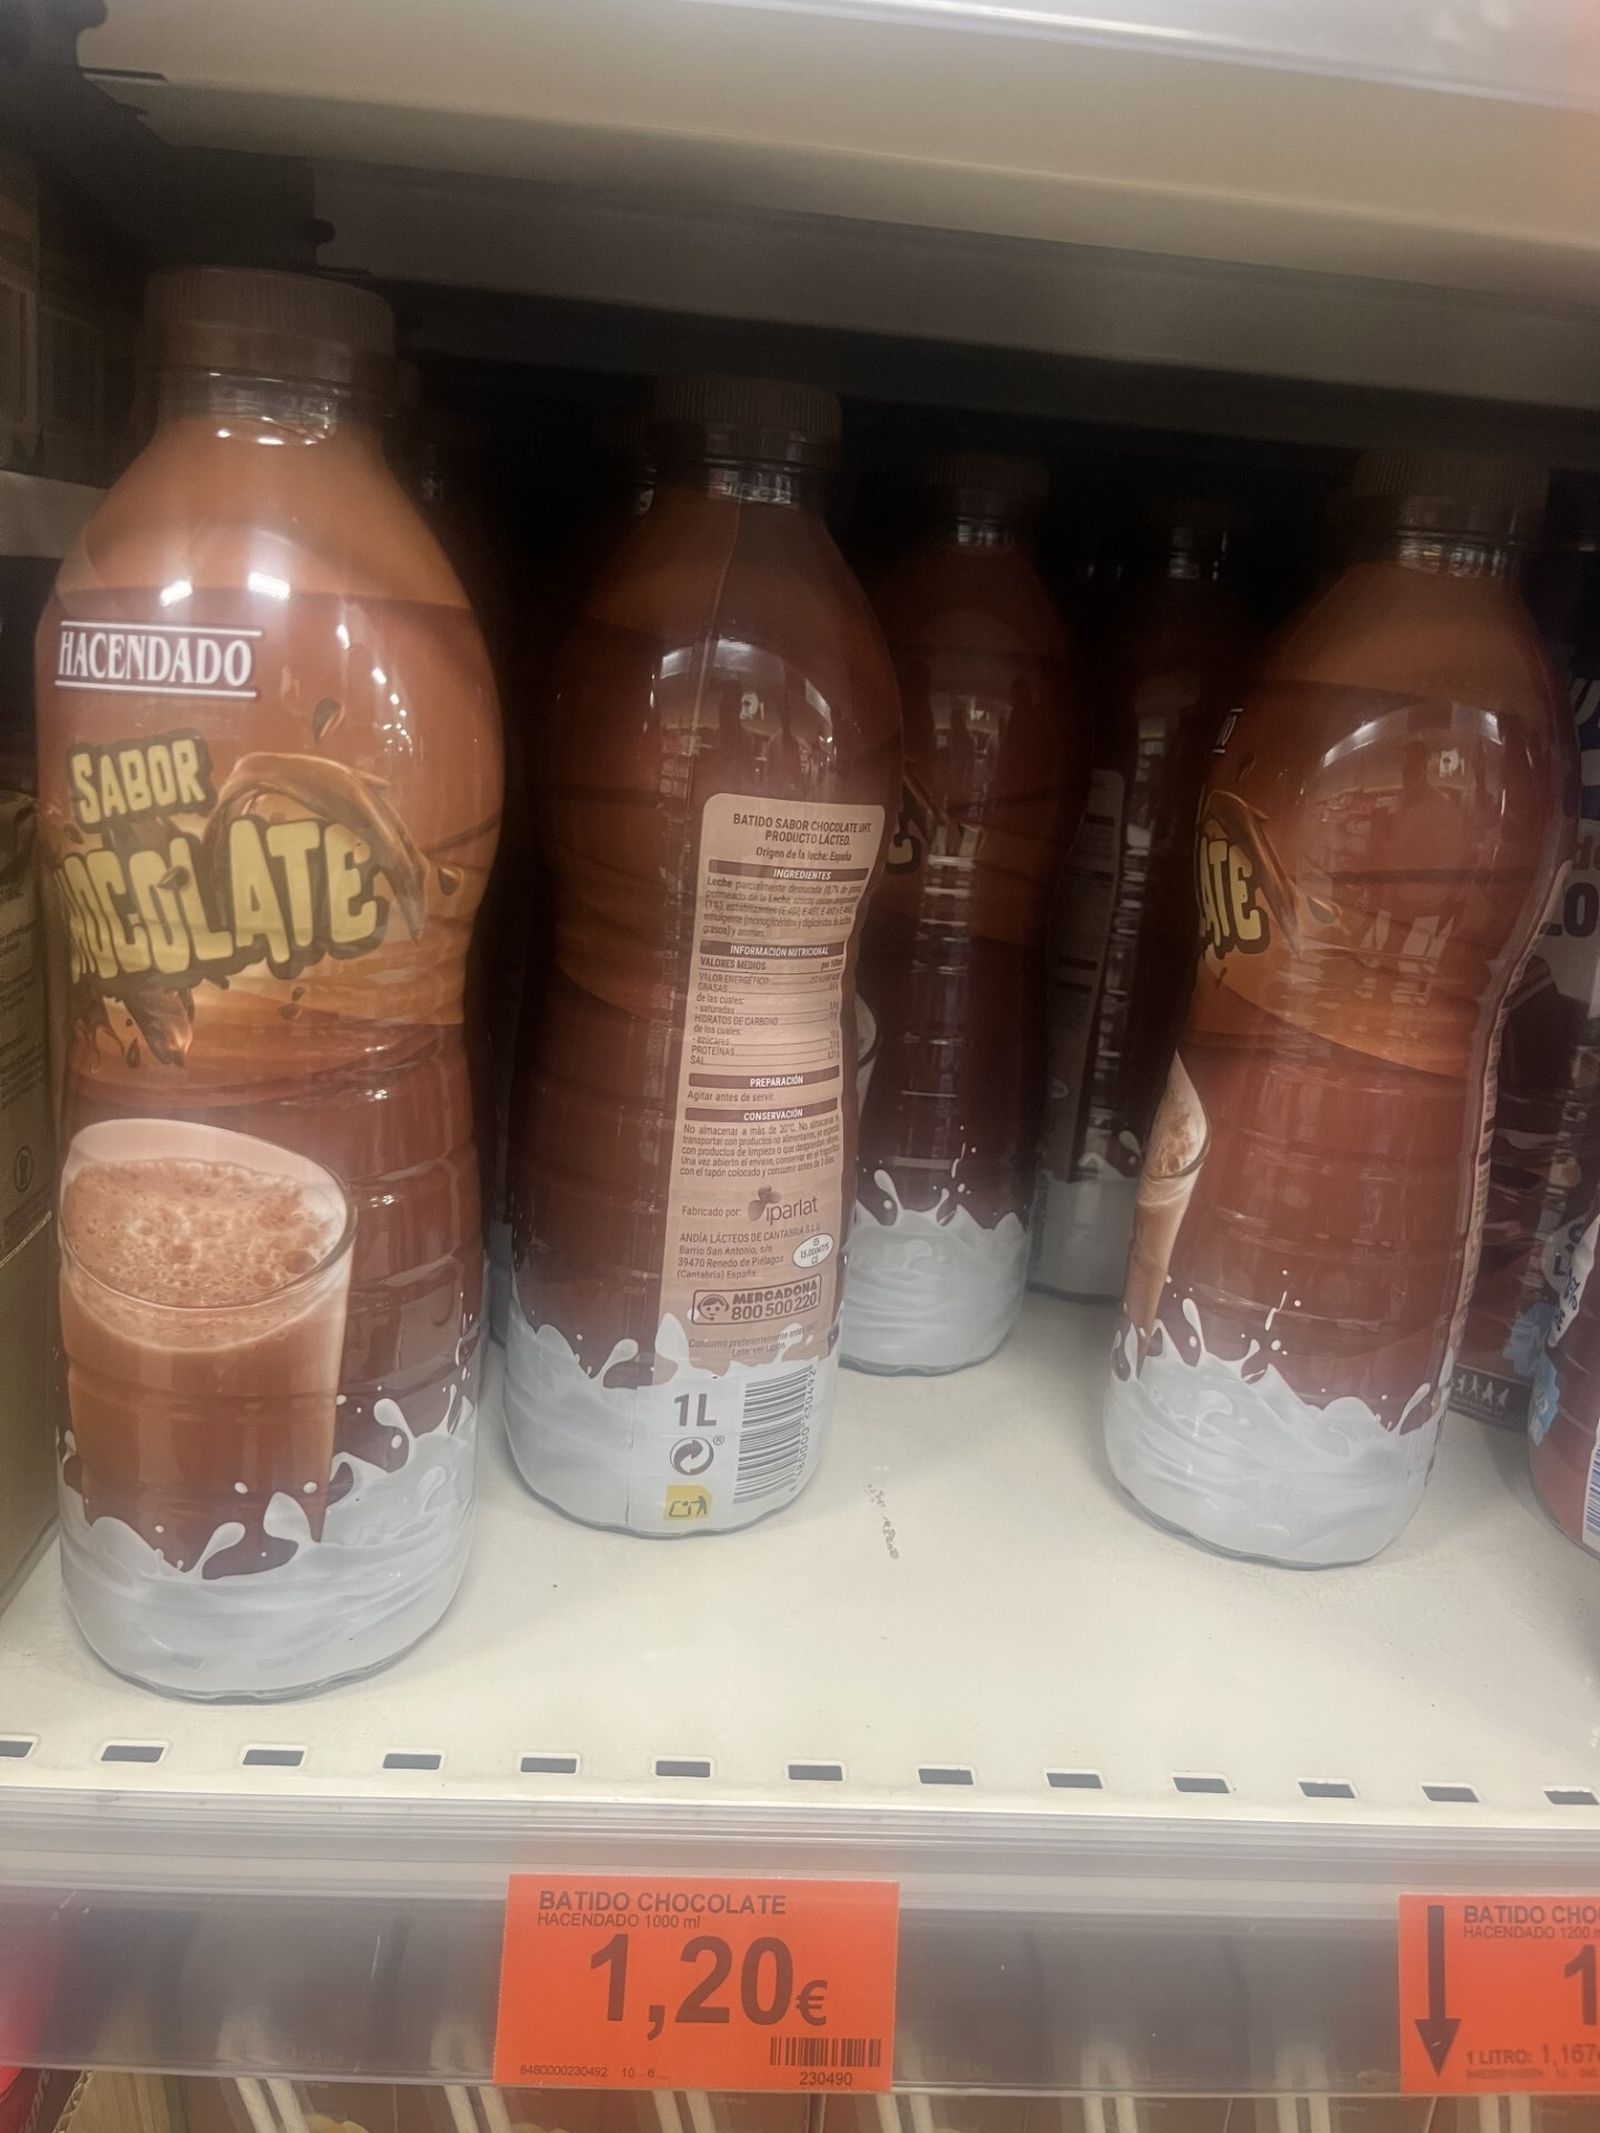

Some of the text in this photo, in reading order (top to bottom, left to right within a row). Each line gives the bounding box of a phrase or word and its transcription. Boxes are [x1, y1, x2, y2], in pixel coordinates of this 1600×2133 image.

[58, 631, 252, 687] HACENDADO
[71, 739, 206, 824] SABOR
[733, 814, 773, 828] BATIDO
[775, 818, 809, 831] SABOR
[810, 821, 858, 833] CHOCOLATE
[765, 831, 817, 844] PRODUCTO
[756, 847, 784, 860] Origen
[786, 849, 796, 859] de
[798, 849, 806, 859] la
[830, 851, 852, 862] España
[773, 869, 832, 880] INGREDIENTES
[708, 876, 732, 888] Leche
[730, 945, 828, 957] INFORMACIÓN NUTRICIONAL
[701, 957, 736, 969] VALORES
[737, 960, 766, 970] MEDIOS
[699, 973, 724, 984] VALOR
[698, 983, 728, 992] GRASAS
[697, 993, 705, 1001] de
[707, 994, 717, 1003] las
[695, 1014, 778, 1026] HIDRATOS DE CARBONO
[694, 1025, 702, 1033] de
[704, 1025, 715, 1034] los
[691, 1045, 735, 1056] PROTEÍNAS
[750, 1075, 804, 1088] PREPARACIÓN
[687, 1090, 713, 1102] Agitar
[715, 1092, 738, 1102] antes
[740, 1091, 750, 1102] de
[743, 1108, 803, 1121] CONSERVACIÓN
[683, 1124, 695, 1134] No
[698, 1124, 738, 1135] almacenar
[750, 1125, 766, 1135] más
[768, 1125, 777, 1135] de
[683, 1135, 723, 1147] transportar
[739, 1137, 772, 1147] productos
[682, 1147, 696, 1155] con
[698, 1147, 736, 1157] productos
[737, 1148, 746, 1157] de
[748, 1147, 775, 1157] limpieza
[783, 1146, 794, 1154] que
[681, 1156, 696, 1165] Una
[713, 1158, 739, 1167] abierto
[741, 1158, 747, 1166] el
[680, 1168, 694, 1176] con
[696, 1167, 703, 1176] el
[704, 1168, 726, 1179] tapón
[728, 1168, 760, 1177] colocado
[682, 1205, 742, 1218] Fabricado por:
[680, 1232, 708, 1243] ANDÍA
[710, 1232, 749, 1244] LÁCTEOS
[751, 1233, 761, 1242] DE
[763, 1227, 805, 1241] CANTABRIA
[679, 1245, 773, 1256] Barrio San Antonio, s/n
[678, 1254, 784, 1268] 39470 Renedo de Piélagos
[676, 1269, 725, 1280] (Cantabria)
[732, 1279, 818, 1305] MERCADONA
[731, 1291, 817, 1321] 800 500 220
[688, 1338, 728, 1349] Consumir
[729, 1331, 788, 1349] preferentemente
[539, 1890, 787, 1915] BATIDO CHOCOLATE
[537, 1913, 701, 1929] HACENDADO 1000 ml
[1464, 1905, 1546, 1924] BATIDO
[1463, 1926, 1555, 1939] HACENDADO
[1561, 1926, 1590, 1939] 1200
[590, 1933, 828, 2042] 1,20€
[1467, 2043, 1600, 2067] 1 LITRO: 1,167
[621, 2067, 636, 2079] 10
[800, 2071, 853, 2086] 230490
